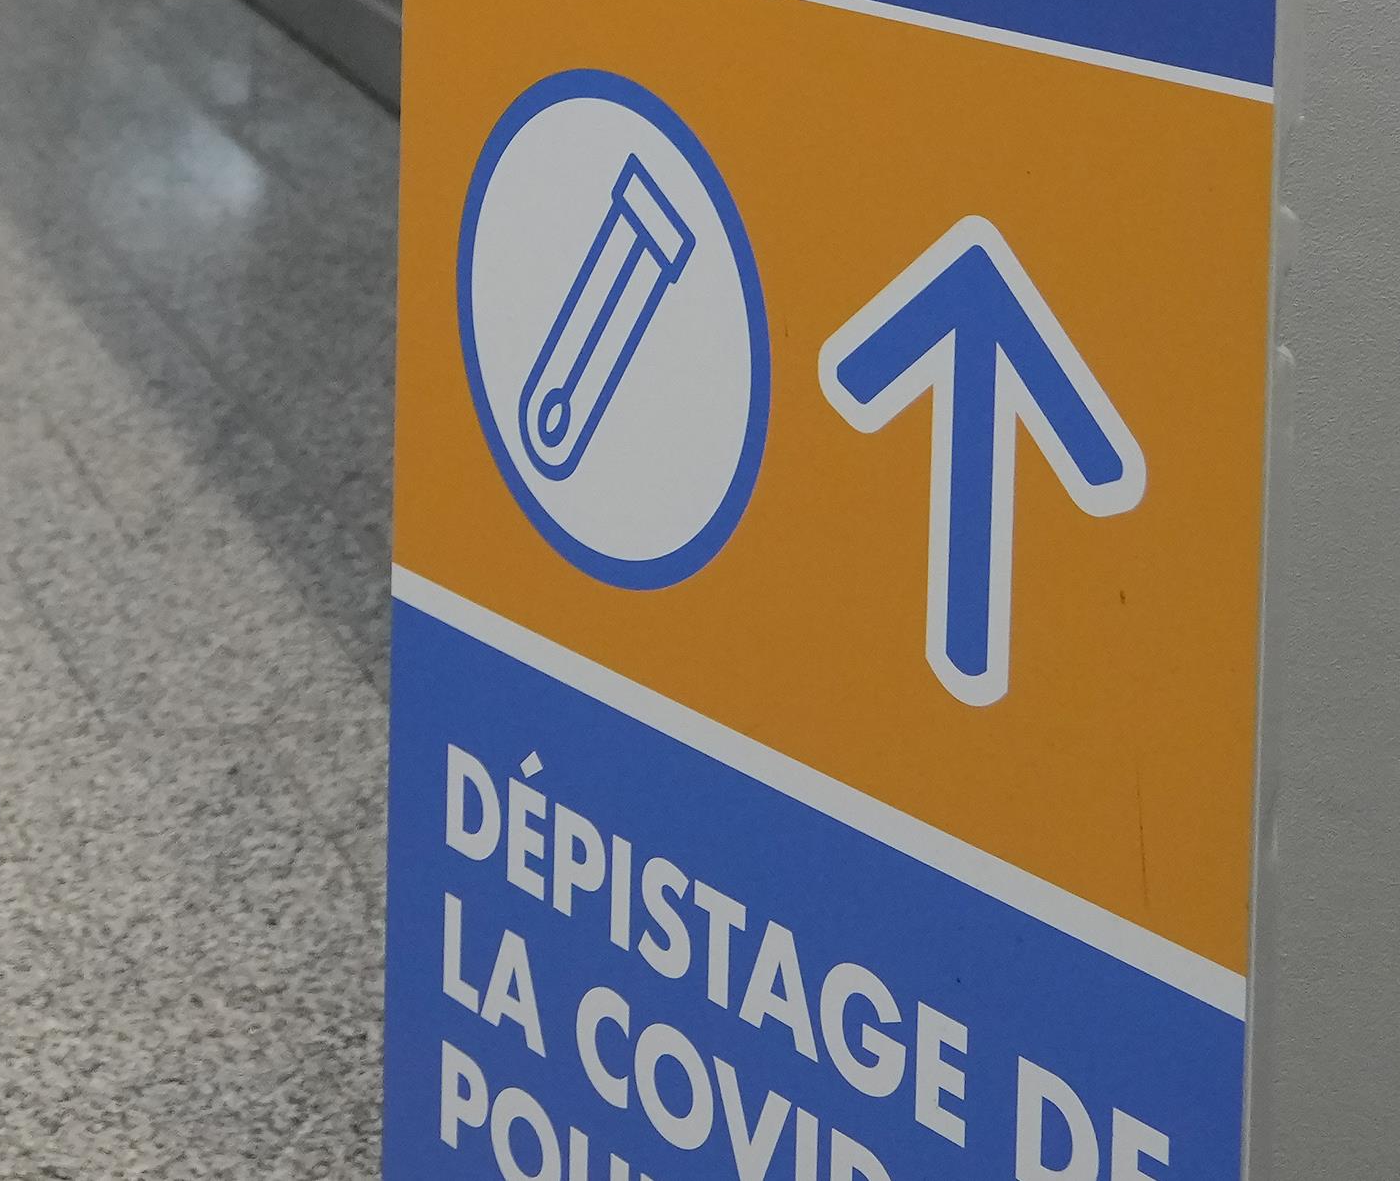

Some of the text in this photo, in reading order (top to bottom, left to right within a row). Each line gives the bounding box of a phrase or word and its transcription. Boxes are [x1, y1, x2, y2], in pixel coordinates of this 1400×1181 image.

[442, 892, 546, 1058] LA
[445, 743, 968, 1148] DÉPISTAGE
[440, 1040, 654, 1181] PO
